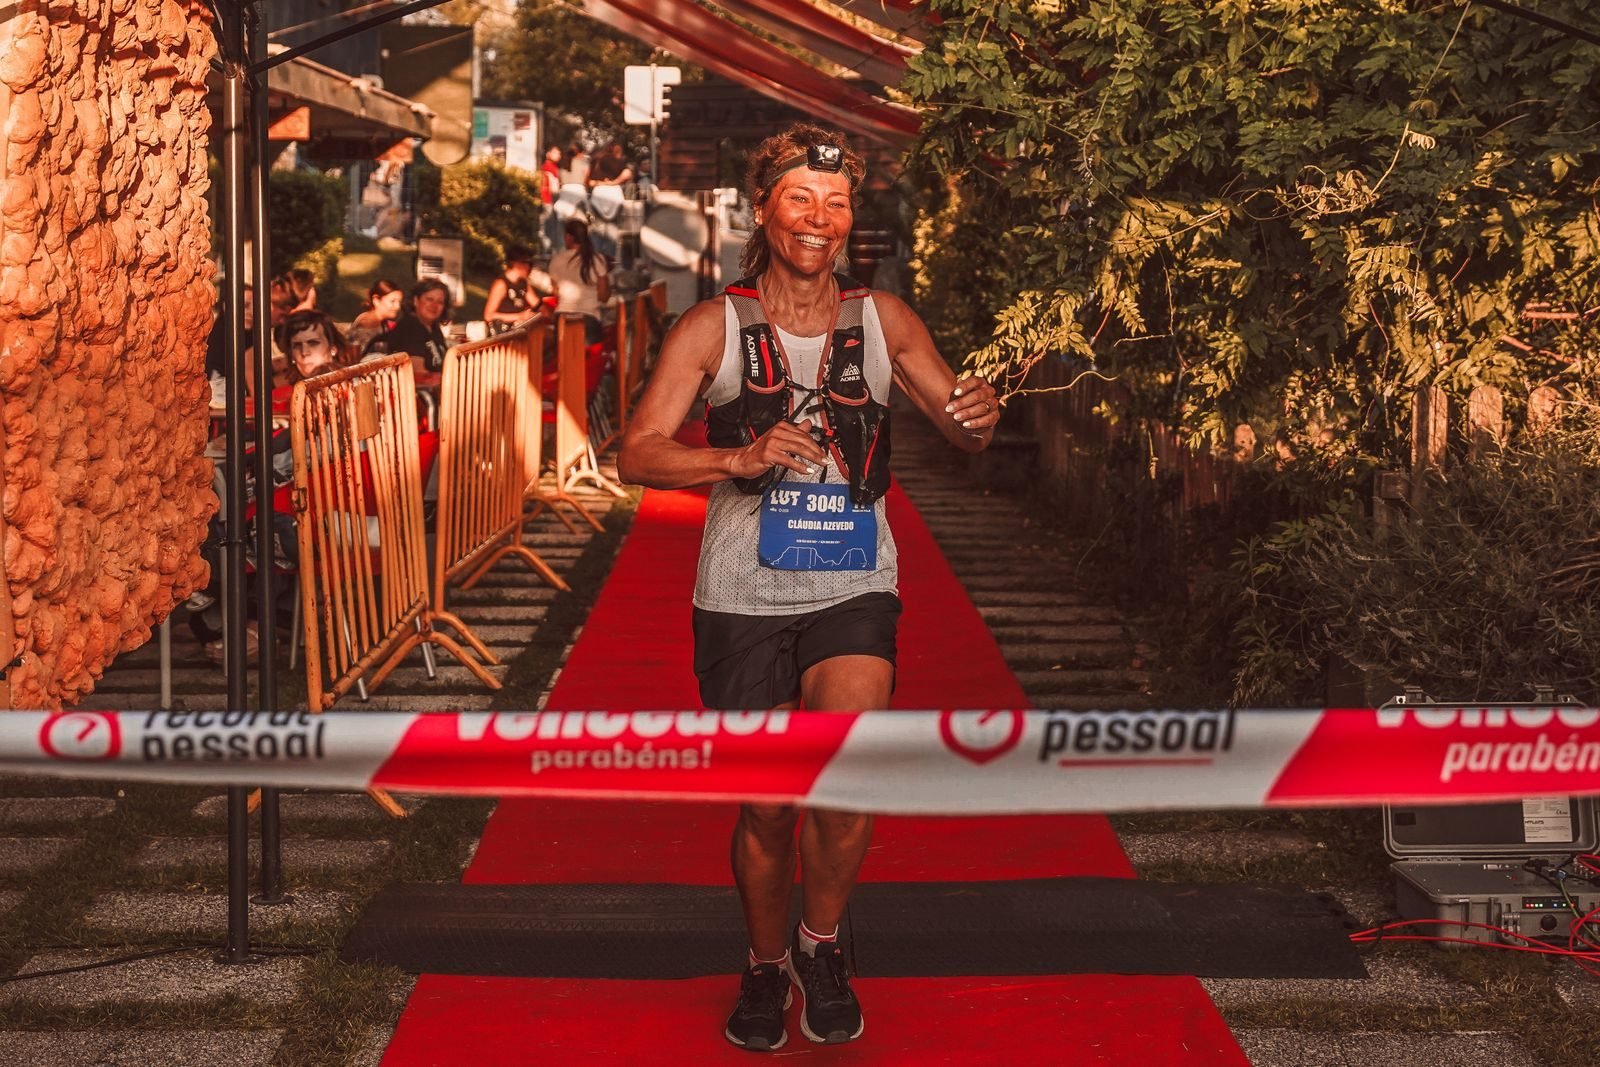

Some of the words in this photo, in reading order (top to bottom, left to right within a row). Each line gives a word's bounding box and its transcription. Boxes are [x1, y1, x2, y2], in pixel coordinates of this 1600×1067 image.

[745, 334, 759, 377] AONIJIE
[770, 488, 801, 506] LUT
[806, 494, 846, 513] 3049
[788, 518, 821, 530] CLÁUDIA
[822, 521, 854, 531] AZEVEDO
[142, 720, 326, 761] pessoal
[1038, 708, 1236, 763] pessoal
[530, 740, 714, 775] parabéns!
